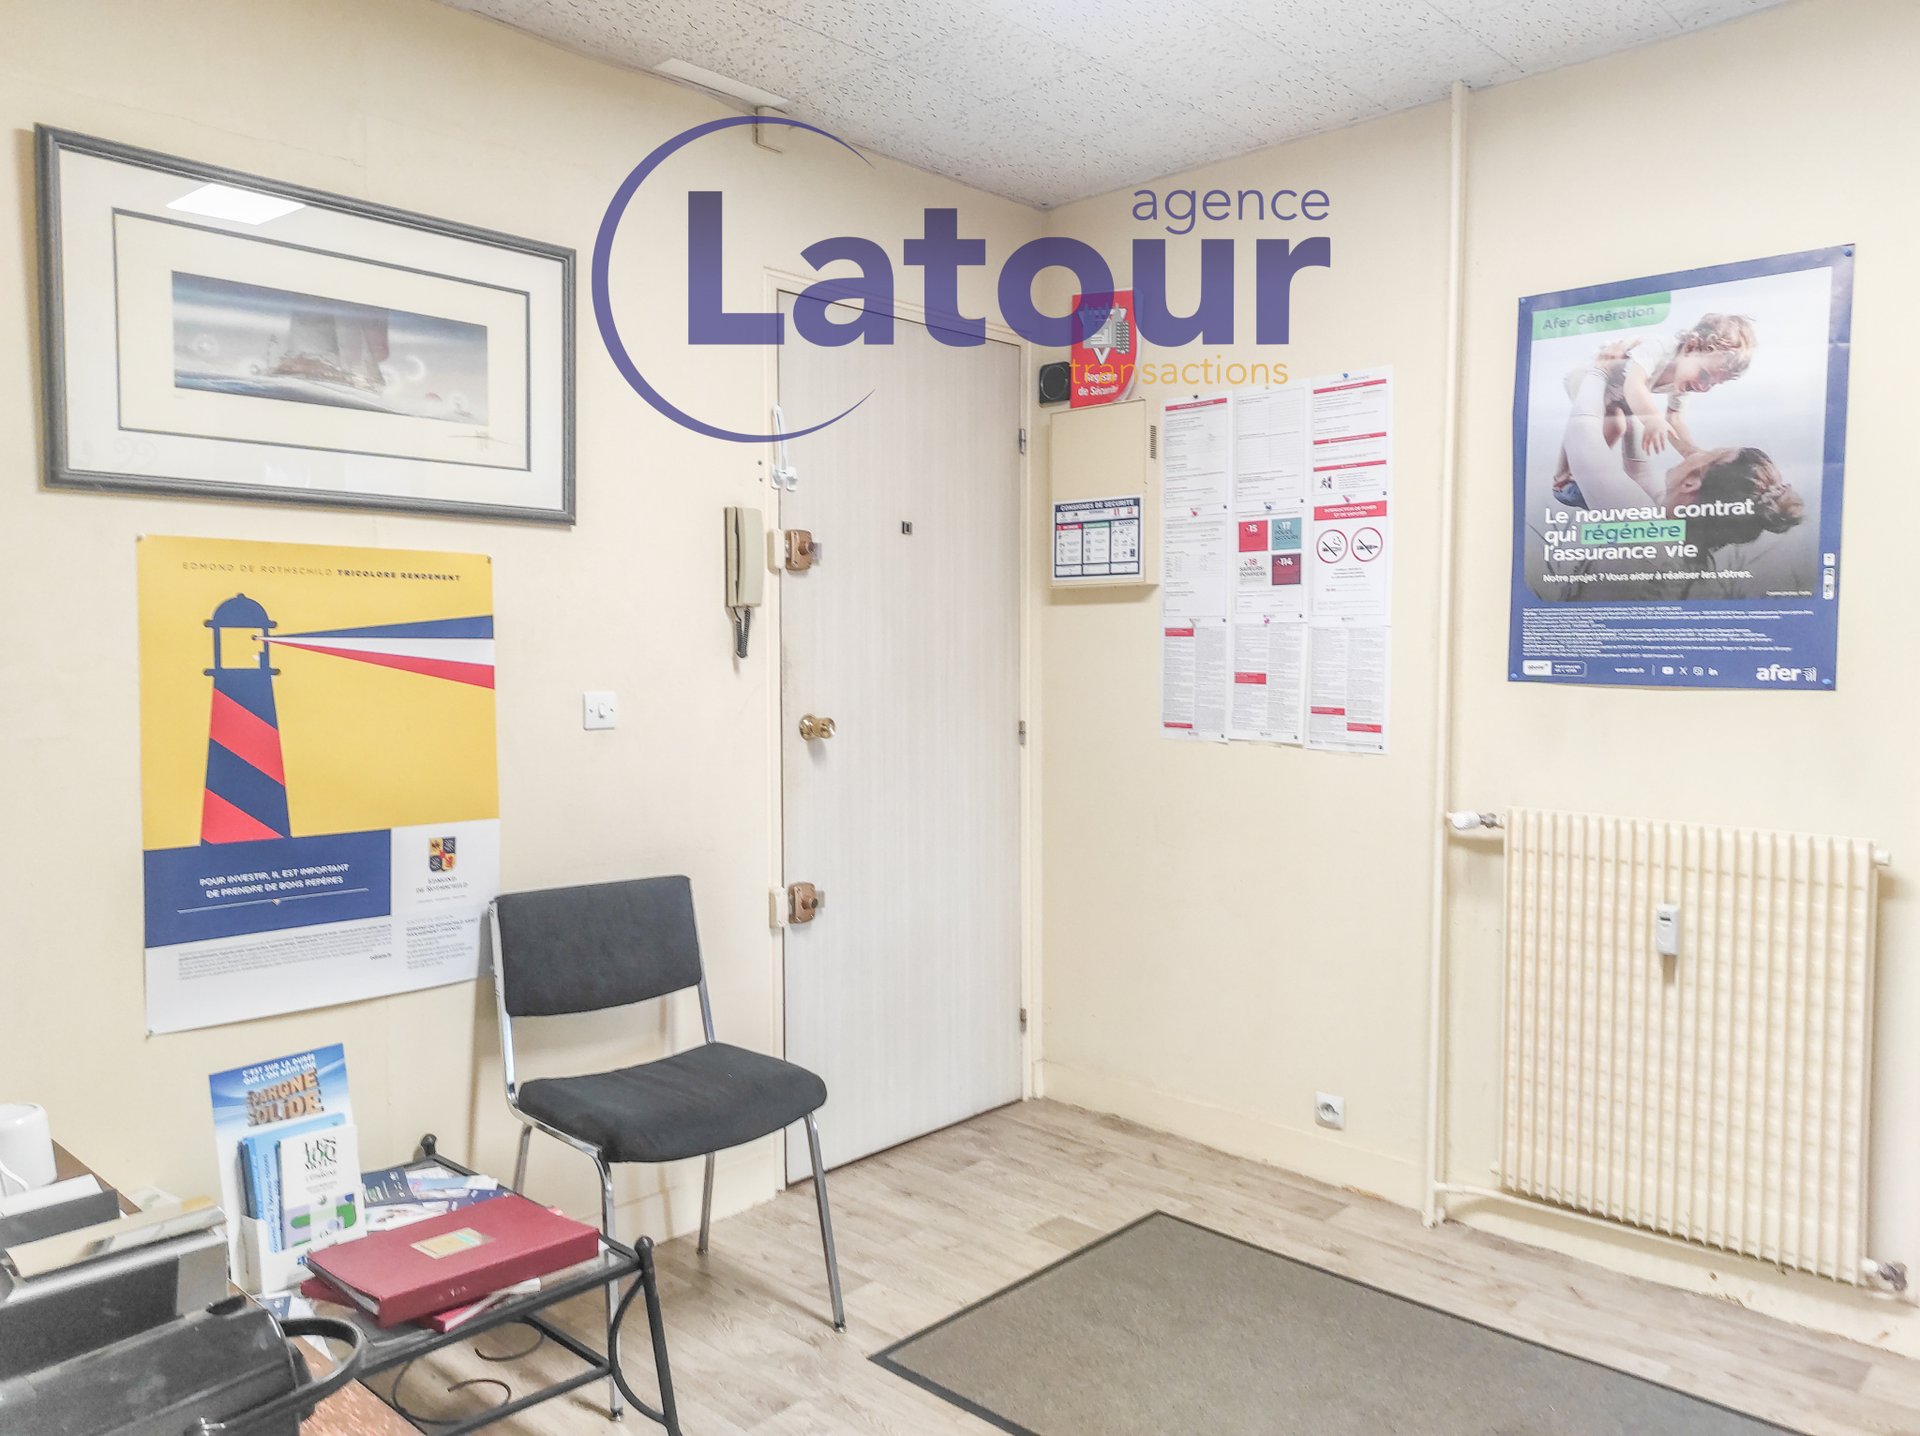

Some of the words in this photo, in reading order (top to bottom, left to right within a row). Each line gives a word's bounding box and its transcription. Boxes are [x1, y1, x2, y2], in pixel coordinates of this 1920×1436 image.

[1542, 317, 1571, 330] Afer
[1576, 306, 1655, 326] Génération
[1077, 387, 1089, 396] de
[1545, 507, 1569, 524] Le
[1576, 505, 1667, 523] nouveau
[1674, 498, 1756, 518] contrat
[1544, 525, 1577, 547] qui
[1584, 522, 1681, 544] régénère
[1543, 543, 1658, 562] l'assurance
[1664, 540, 1699, 558] vie
[182, 561, 235, 573] EDMOND
[240, 564, 254, 574] DE
[260, 565, 333, 577] ROTHSCHILD
[337, 568, 397, 579] TRICOLORE
[400, 571, 462, 582] RENDEMENT
[1543, 573, 1569, 583] Notre
[1569, 572, 1598, 584] projet
[1598, 572, 1605, 582] ?
[1605, 572, 1629, 581] Vous
[1629, 571, 1654, 581] aider
[1655, 570, 1662, 580] à
[1662, 570, 1701, 580] réaliser
[1701, 570, 1717, 579] les
[1756, 663, 1802, 682] afer
[200, 876, 227, 887] POUR
[281, 868, 299, 878] EST
[300, 863, 350, 876] IMPORTANT
[205, 889, 220, 899] DE
[221, 885, 264, 897] PRENDRE
[265, 882, 278, 892] DE
[278, 880, 304, 891] BONS
